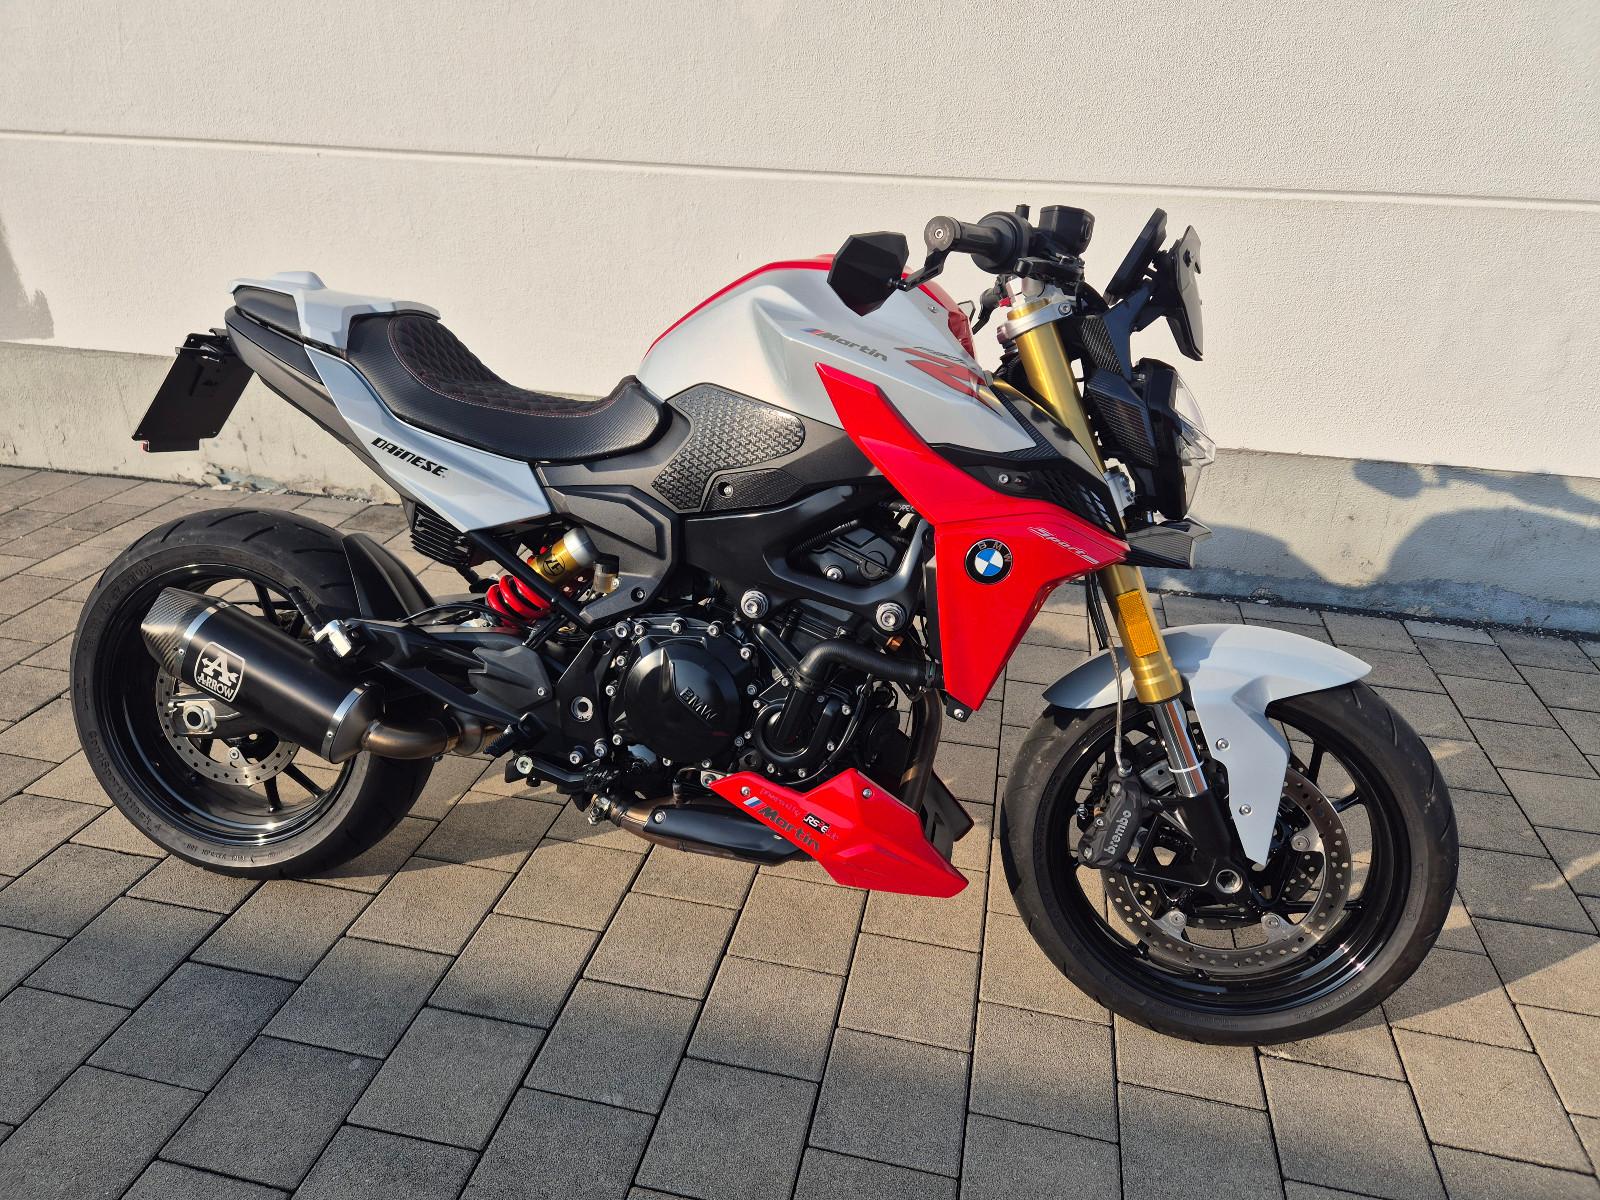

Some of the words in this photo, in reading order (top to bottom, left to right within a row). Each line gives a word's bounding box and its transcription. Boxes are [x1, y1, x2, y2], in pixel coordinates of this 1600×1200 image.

[816, 332, 888, 363] Martin
[371, 437, 448, 477] DAINESE
[197, 673, 235, 699] ARROW
[680, 686, 718, 720] BMW
[757, 806, 820, 852] Martin
[1104, 810, 1131, 855] brembo
